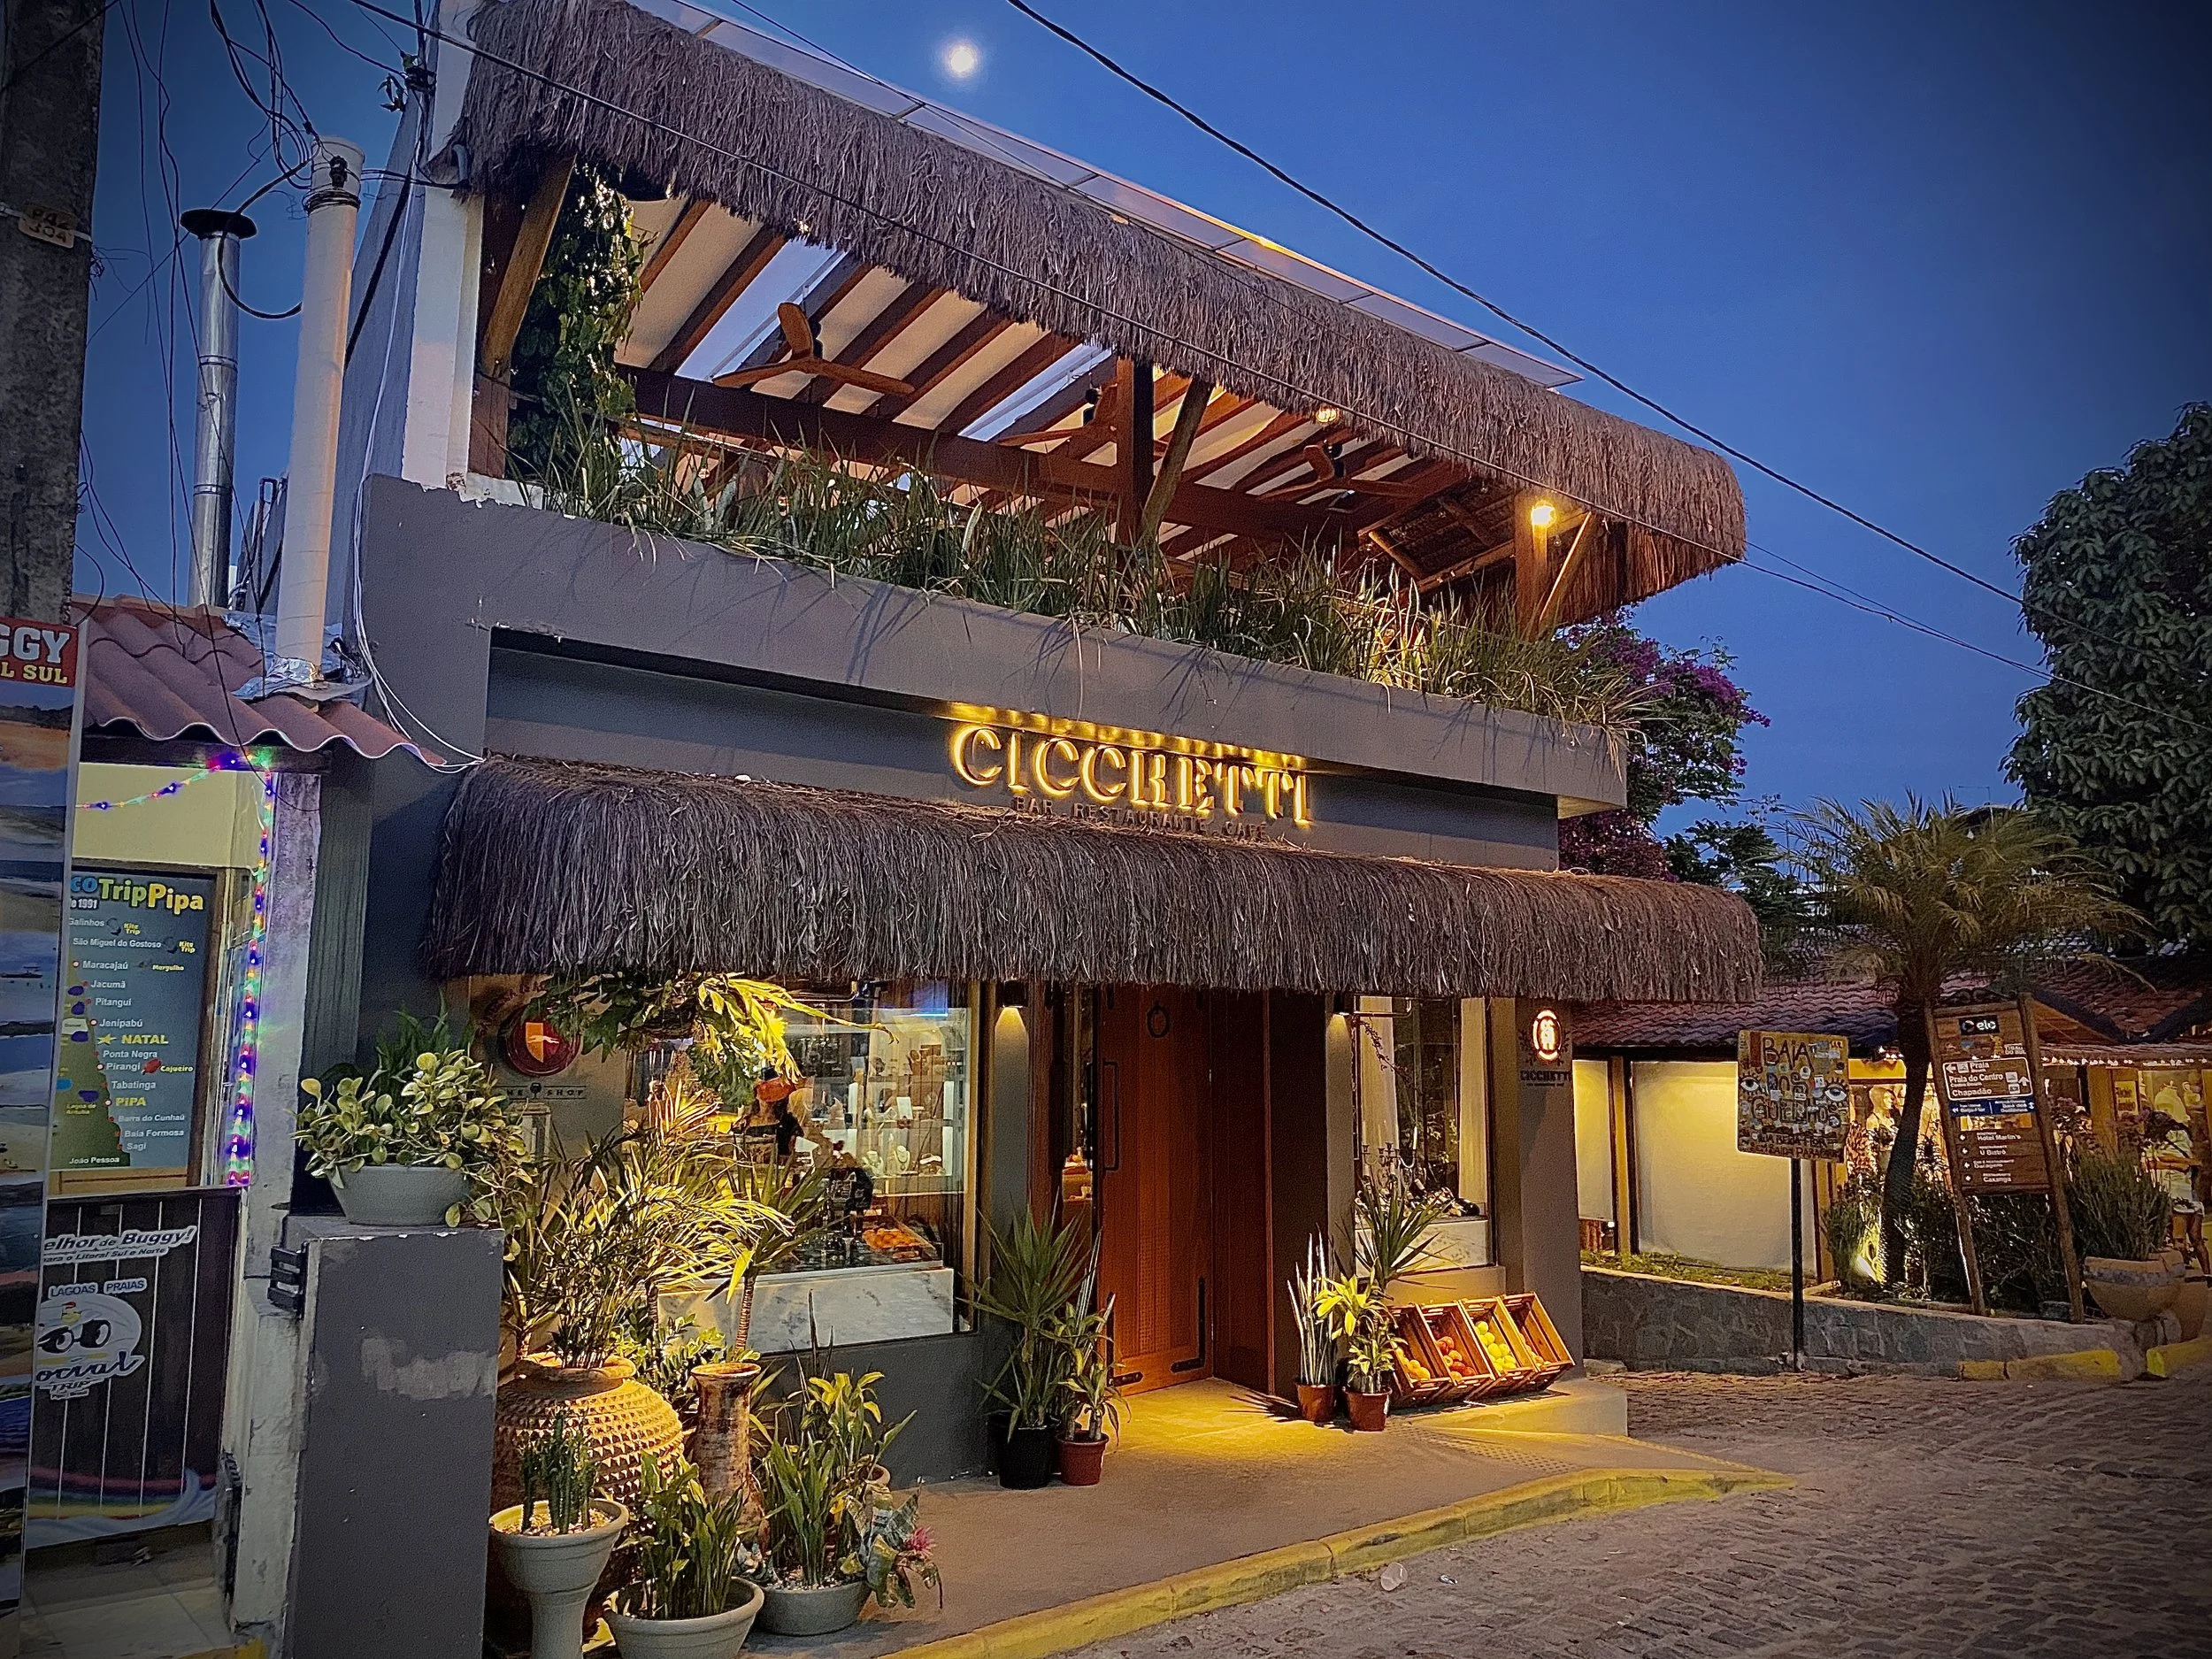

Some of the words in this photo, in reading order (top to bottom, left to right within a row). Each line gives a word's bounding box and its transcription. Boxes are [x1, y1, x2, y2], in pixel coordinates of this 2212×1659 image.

[23, 664, 68, 684] SUL
[954, 723, 1313, 826] CICCHETTI
[1014, 796, 1053, 814] BAR
[1073, 803, 1208, 834] RESTAURANTE
[78, 899, 98, 910] 1991
[69, 918, 105, 927] Galinhos
[90, 938, 116, 948] Miguel
[130, 940, 162, 949] Gostoso
[83, 960, 128, 971] Maracajaú
[96, 998, 132, 1007] Pitangui
[99, 1018, 143, 1028] Jenipabú
[121, 1034, 169, 1045] NATAL
[132, 1050, 157, 1060] Negra
[106, 1063, 141, 1072] Pirangi
[111, 1081, 157, 1090] Tabatinga
[1952, 1087, 1993, 1097] Chapadão
[115, 1097, 146, 1106] PIPA
[127, 1142, 147, 1151] Sagi
[44, 1237, 99, 1250] elhor
[120, 1227, 195, 1246] Buggy!
[50, 1285, 96, 1297] LAGOAS
[106, 1279, 145, 1291] PRAIAS
